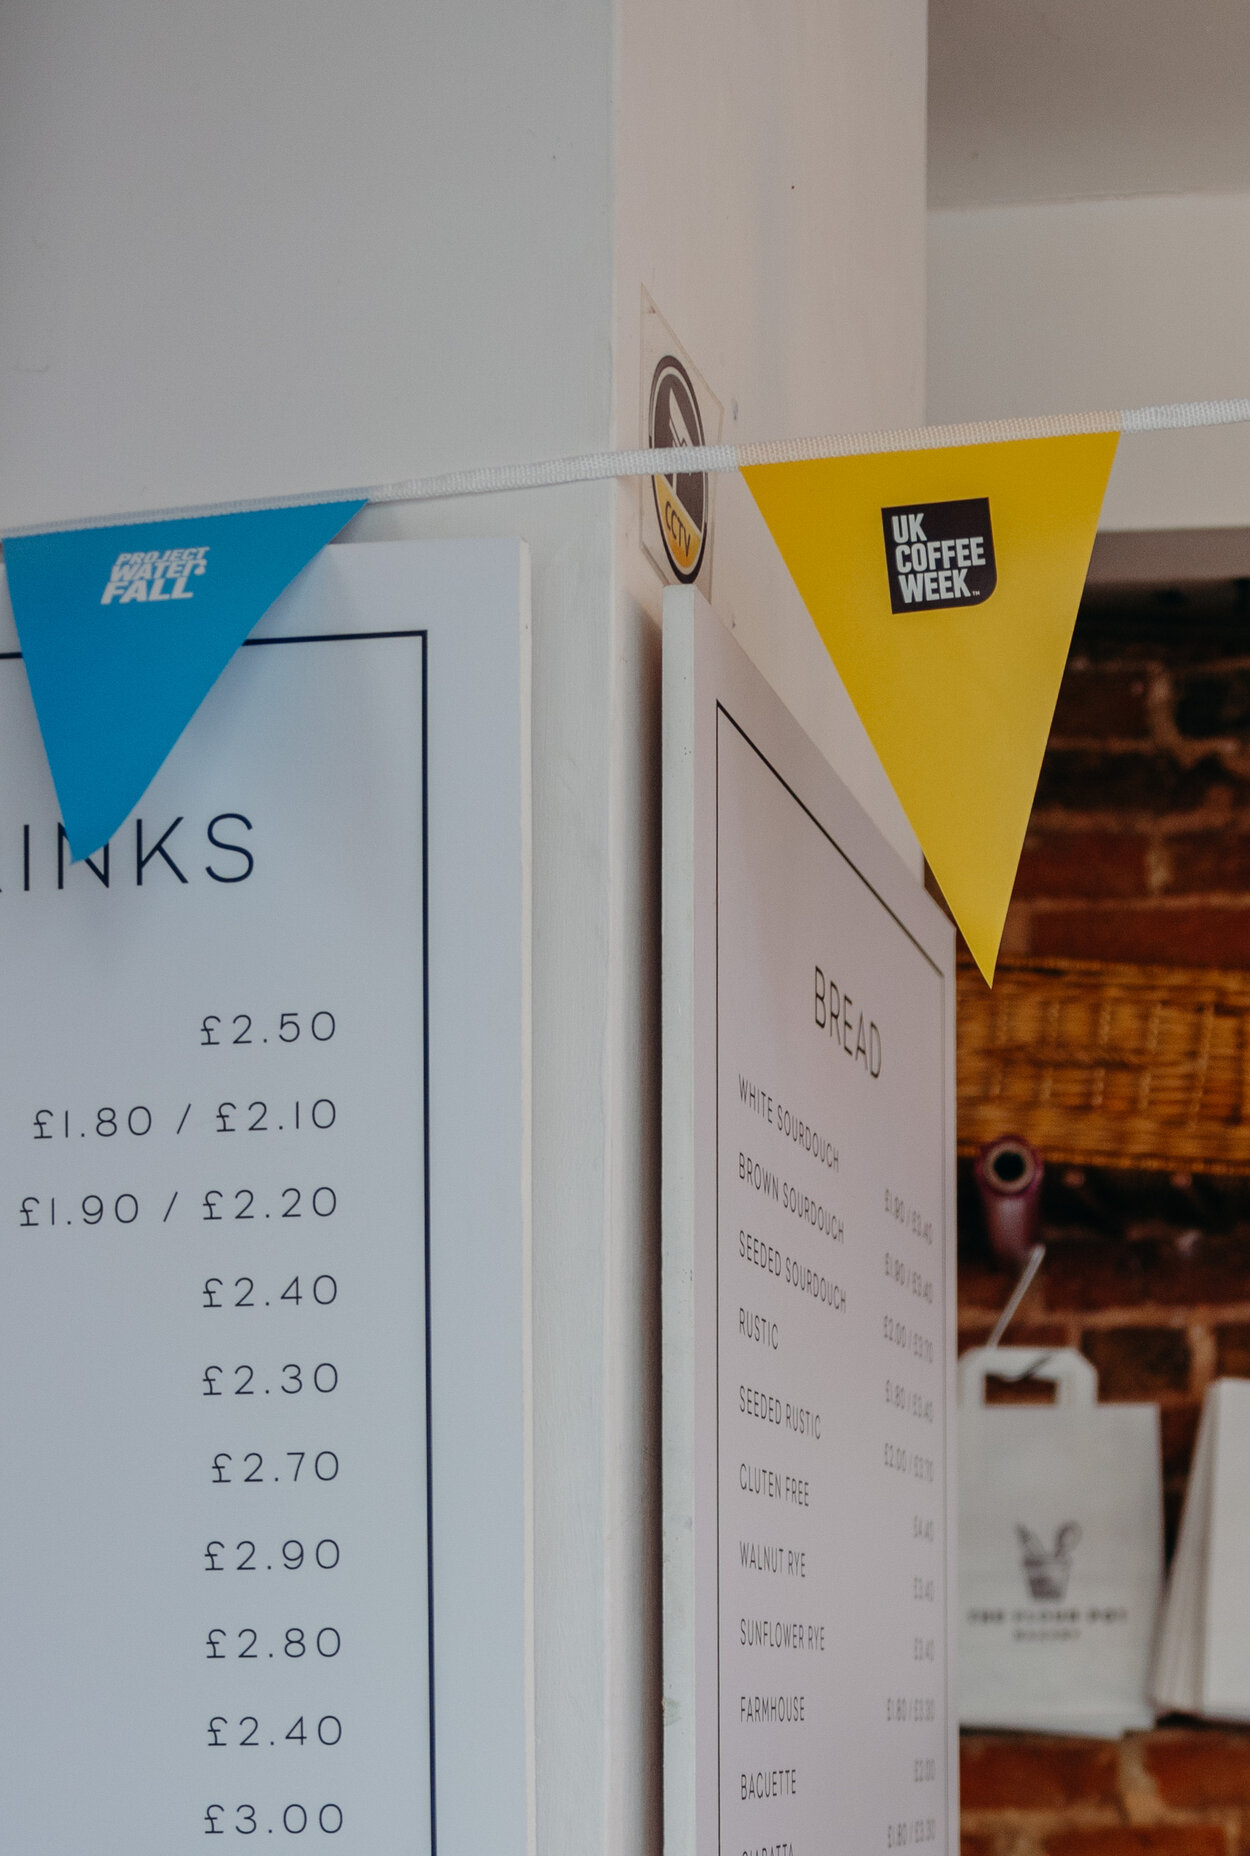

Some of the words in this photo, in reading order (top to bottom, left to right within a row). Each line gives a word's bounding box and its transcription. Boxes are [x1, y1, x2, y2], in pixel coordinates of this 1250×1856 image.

[664, 500, 691, 557] CCTV
[891, 513, 927, 543] UK
[113, 546, 210, 566] PROJECT
[895, 536, 986, 573] COFFEE
[100, 577, 194, 605] FALL
[0, 812, 254, 893] INKS
[200, 1010, 337, 1046] £2.50
[815, 965, 882, 1080] BREAD
[738, 1073, 773, 1124] WHITE
[33, 1105, 152, 1139] £1.80
[176, 1103, 192, 1136] /
[215, 1098, 337, 1132] £2.10
[738, 1151, 779, 1202] BROWN
[19, 1193, 139, 1226] £1.90
[163, 1191, 179, 1224] /
[202, 1186, 338, 1220] £2.20
[738, 1230, 782, 1277] SEEDED
[202, 1274, 338, 1308] £2.40
[738, 1307, 779, 1350] RUSTIC
[202, 1362, 339, 1396] £2.30
[738, 1385, 782, 1426] SEEDED
[786, 1403, 821, 1440] RUSTIC
[211, 1451, 340, 1483] £2.70
[739, 1463, 782, 1499] GLUTEN
[785, 1476, 809, 1507] FREE
[204, 1538, 340, 1571] £2.90
[739, 1540, 784, 1574] WALNUT
[787, 1550, 806, 1578] RYE
[205, 1627, 341, 1659] £2.80
[740, 1618, 804, 1649] SUNFLOWER
[808, 1624, 825, 1651] RYE
[740, 1696, 805, 1723] FARMHOUSE
[207, 1714, 342, 1747] £2.40
[204, 1803, 344, 1835] £3.00
